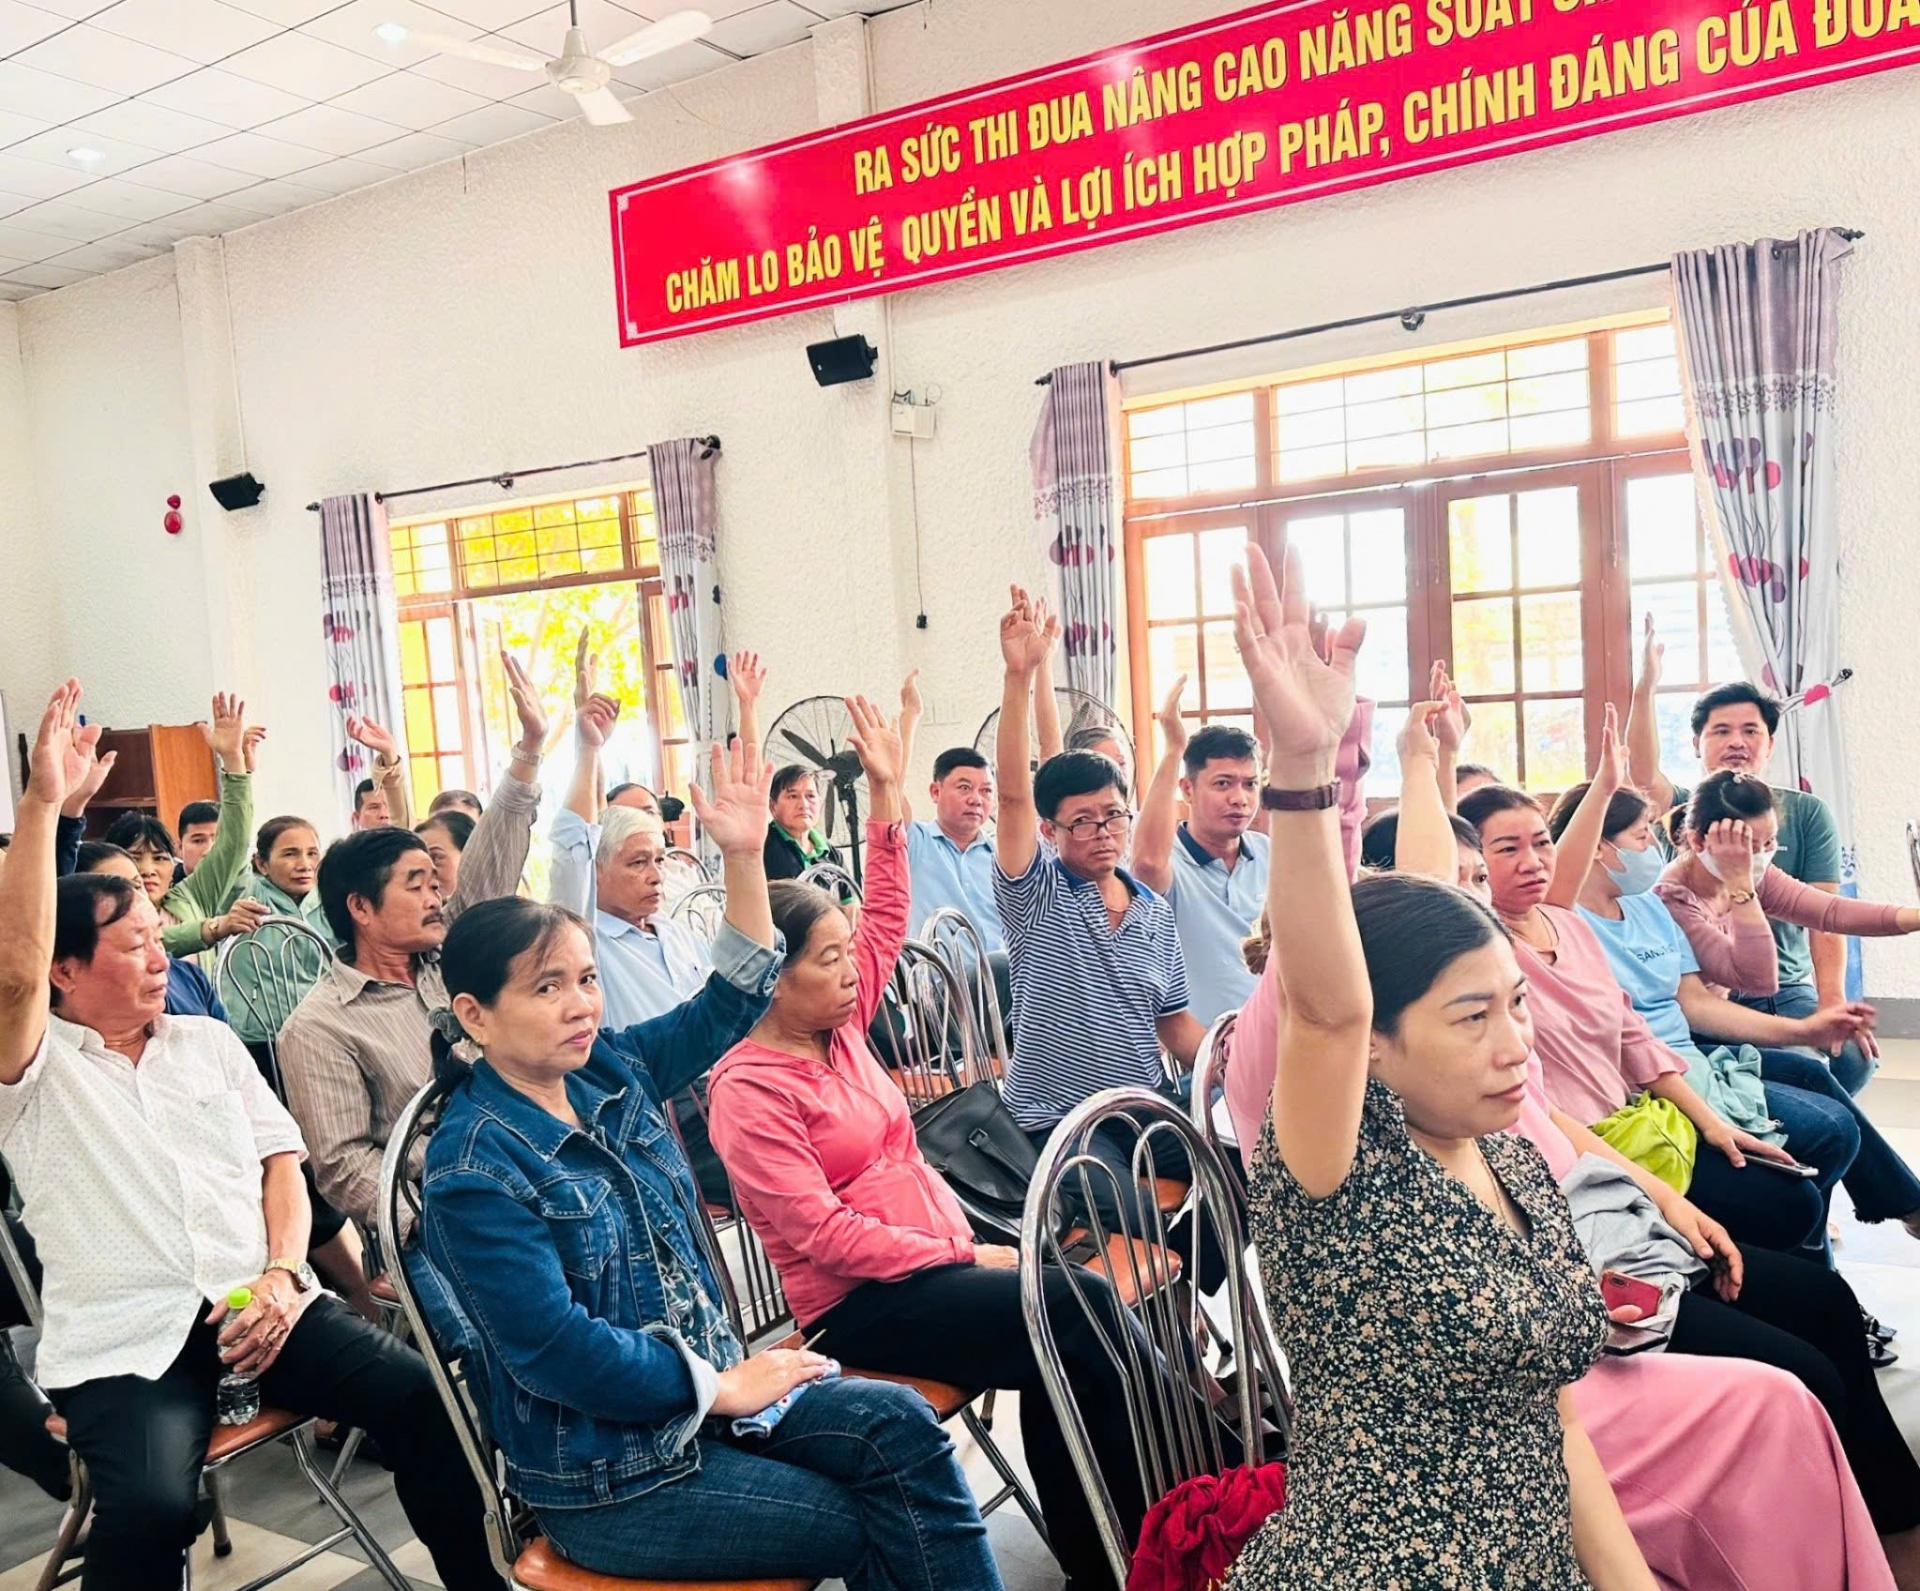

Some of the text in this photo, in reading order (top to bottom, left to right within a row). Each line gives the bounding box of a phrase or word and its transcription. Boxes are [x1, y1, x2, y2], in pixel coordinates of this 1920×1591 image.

[666, 256, 740, 313] CHĂM
[747, 250, 779, 296] LO
[787, 225, 842, 287] BẢO
[849, 215, 885, 278] VỆ
[902, 184, 1001, 263] QUYỀN
[1010, 175, 1054, 235] VÀ
[1061, 167, 1113, 230] LỢI
[1124, 150, 1182, 210] ÍCH
[1193, 131, 1267, 198] HỢP
[1280, 98, 1391, 173] PHÁP,
[1403, 64, 1536, 143] CHÍNH
[1549, 29, 1680, 110] ĐÁNG
[855, 146, 893, 195] RA
[902, 122, 961, 183] SỨC
[969, 111, 1019, 165] THI
[1028, 92, 1093, 151] ĐUA
[1103, 61, 1202, 131] NÂNG
[1214, 38, 1287, 101] CAO
[1300, 3, 1413, 79] NĂNG
